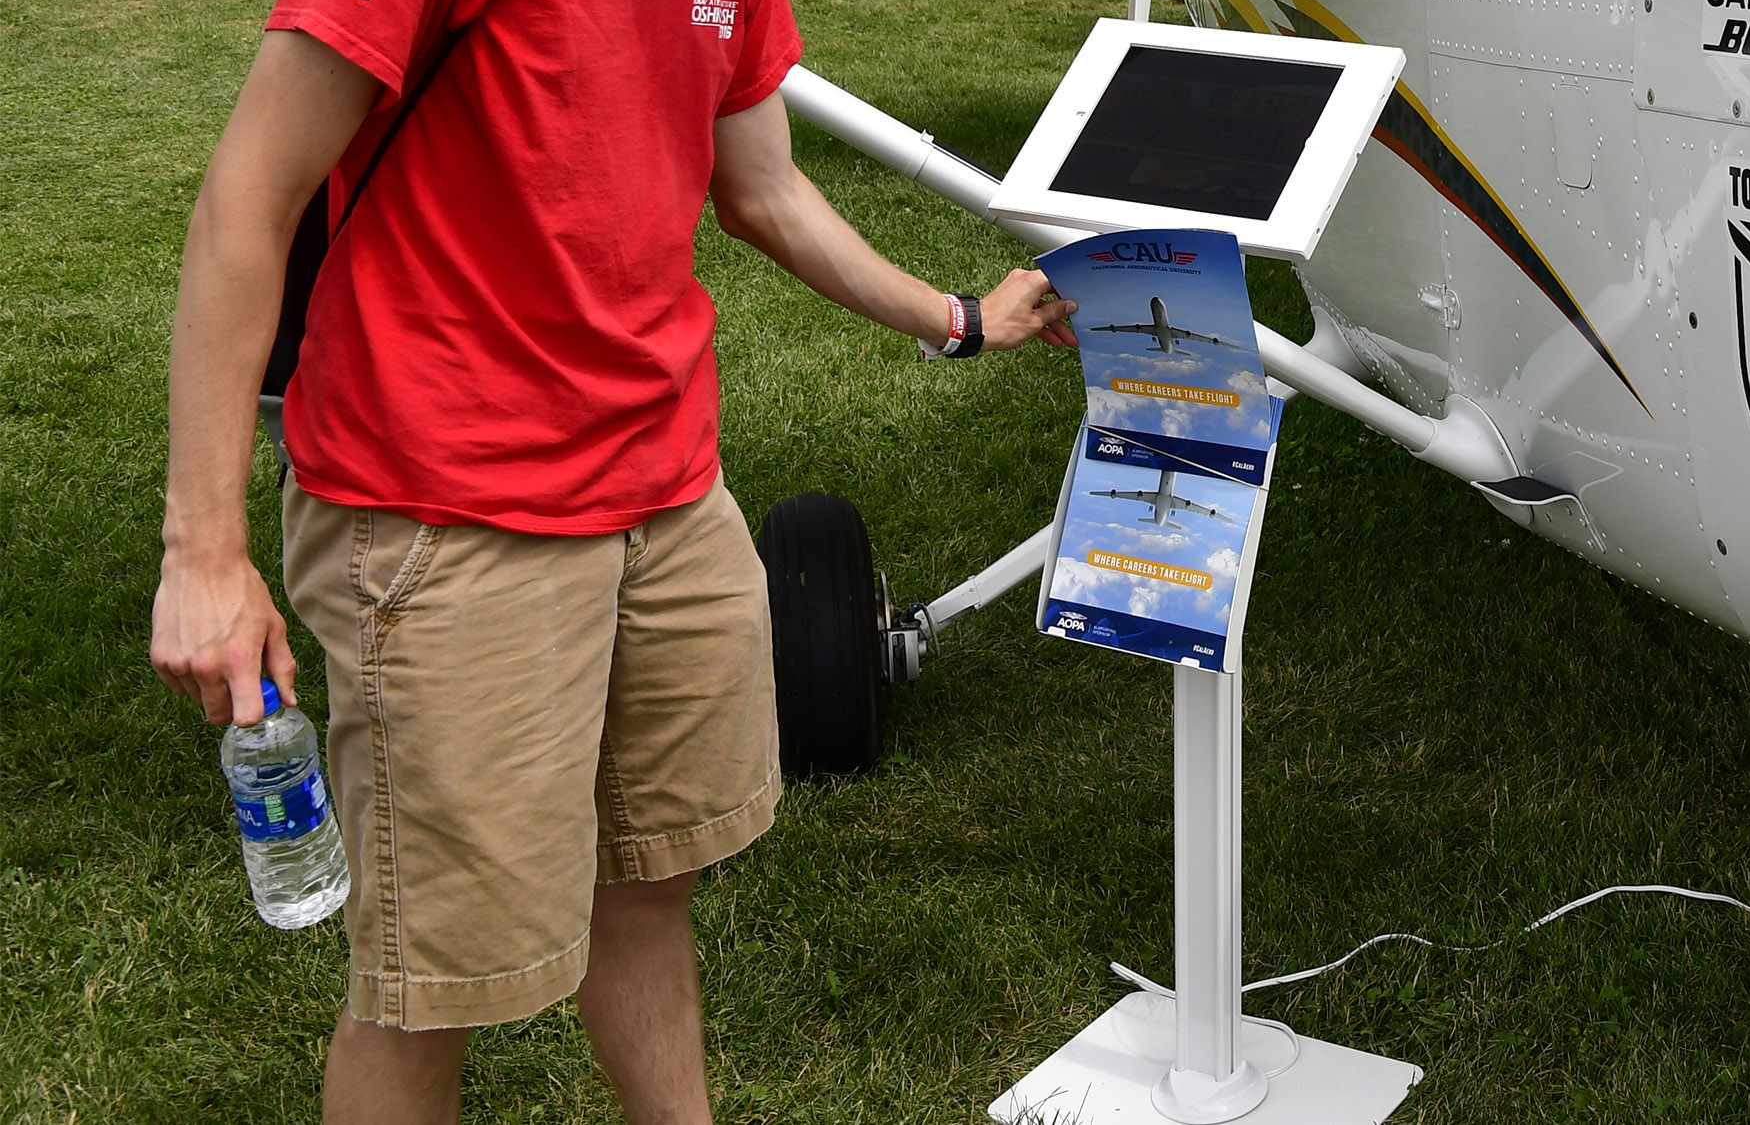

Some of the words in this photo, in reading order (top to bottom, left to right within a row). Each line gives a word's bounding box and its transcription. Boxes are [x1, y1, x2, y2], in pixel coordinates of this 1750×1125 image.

[1112, 242, 1174, 263] CAU
[1169, 267, 1202, 275] UNIVERSITY
[1117, 381, 1144, 393] WHERE
[1146, 384, 1182, 398] CAREERS
[1184, 389, 1204, 400] TAKE
[1206, 392, 1234, 404] FLIGHT
[1097, 443, 1124, 456] AOPA
[1094, 552, 1121, 568] WHERE
[1123, 559, 1158, 576] CAREERS
[1160, 567, 1180, 580] TAKE
[1181, 572, 1207, 586] FLIGHT
[1057, 617, 1085, 632] AOPA
